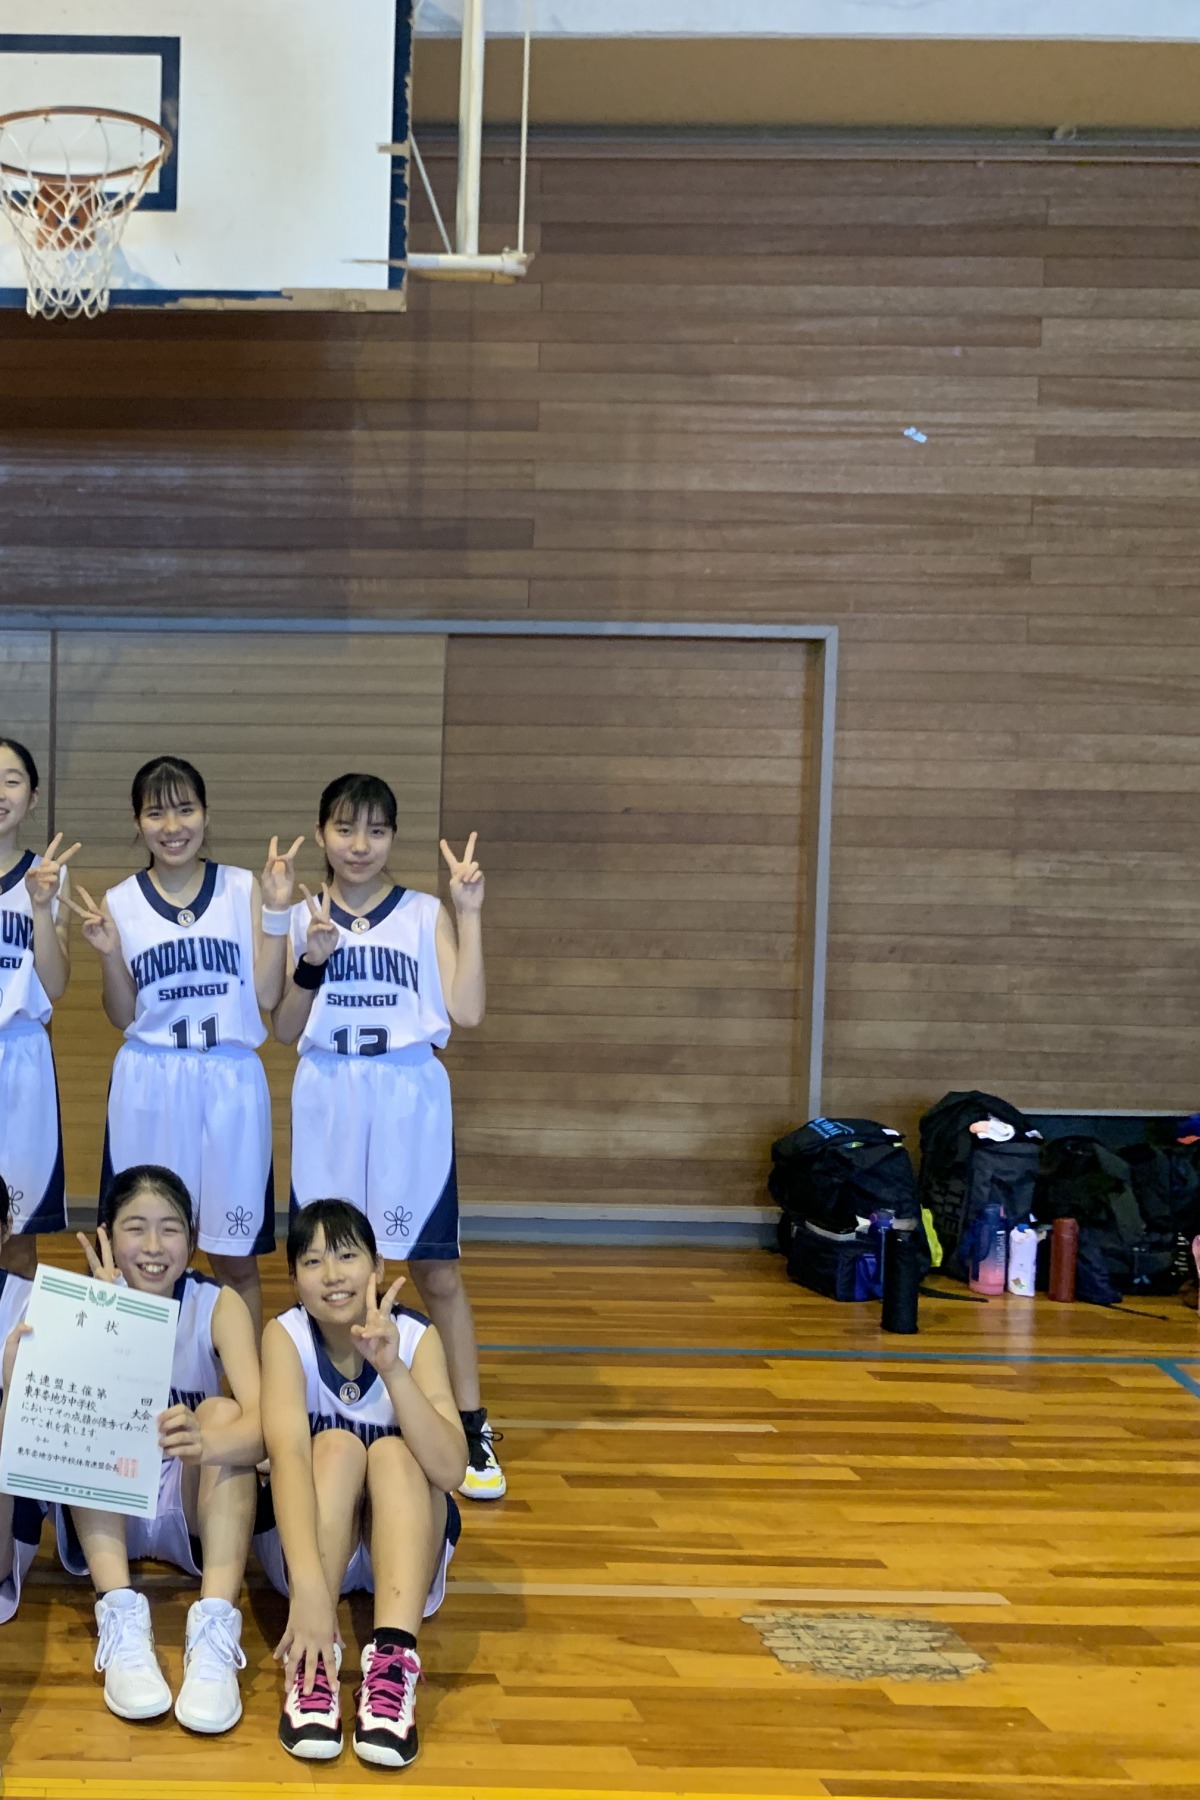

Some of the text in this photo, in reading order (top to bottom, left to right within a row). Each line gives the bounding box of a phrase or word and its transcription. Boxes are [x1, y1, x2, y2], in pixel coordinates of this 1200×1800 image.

[131, 937, 198, 990] KINDAI
[158, 981, 228, 1001] SHINGU
[326, 993, 398, 1007] SHINGU
[169, 1013, 220, 1050] 11
[330, 1025, 391, 1057] 12
[141, 1397, 154, 1407] 回
[131, 1409, 153, 1421] 大会
